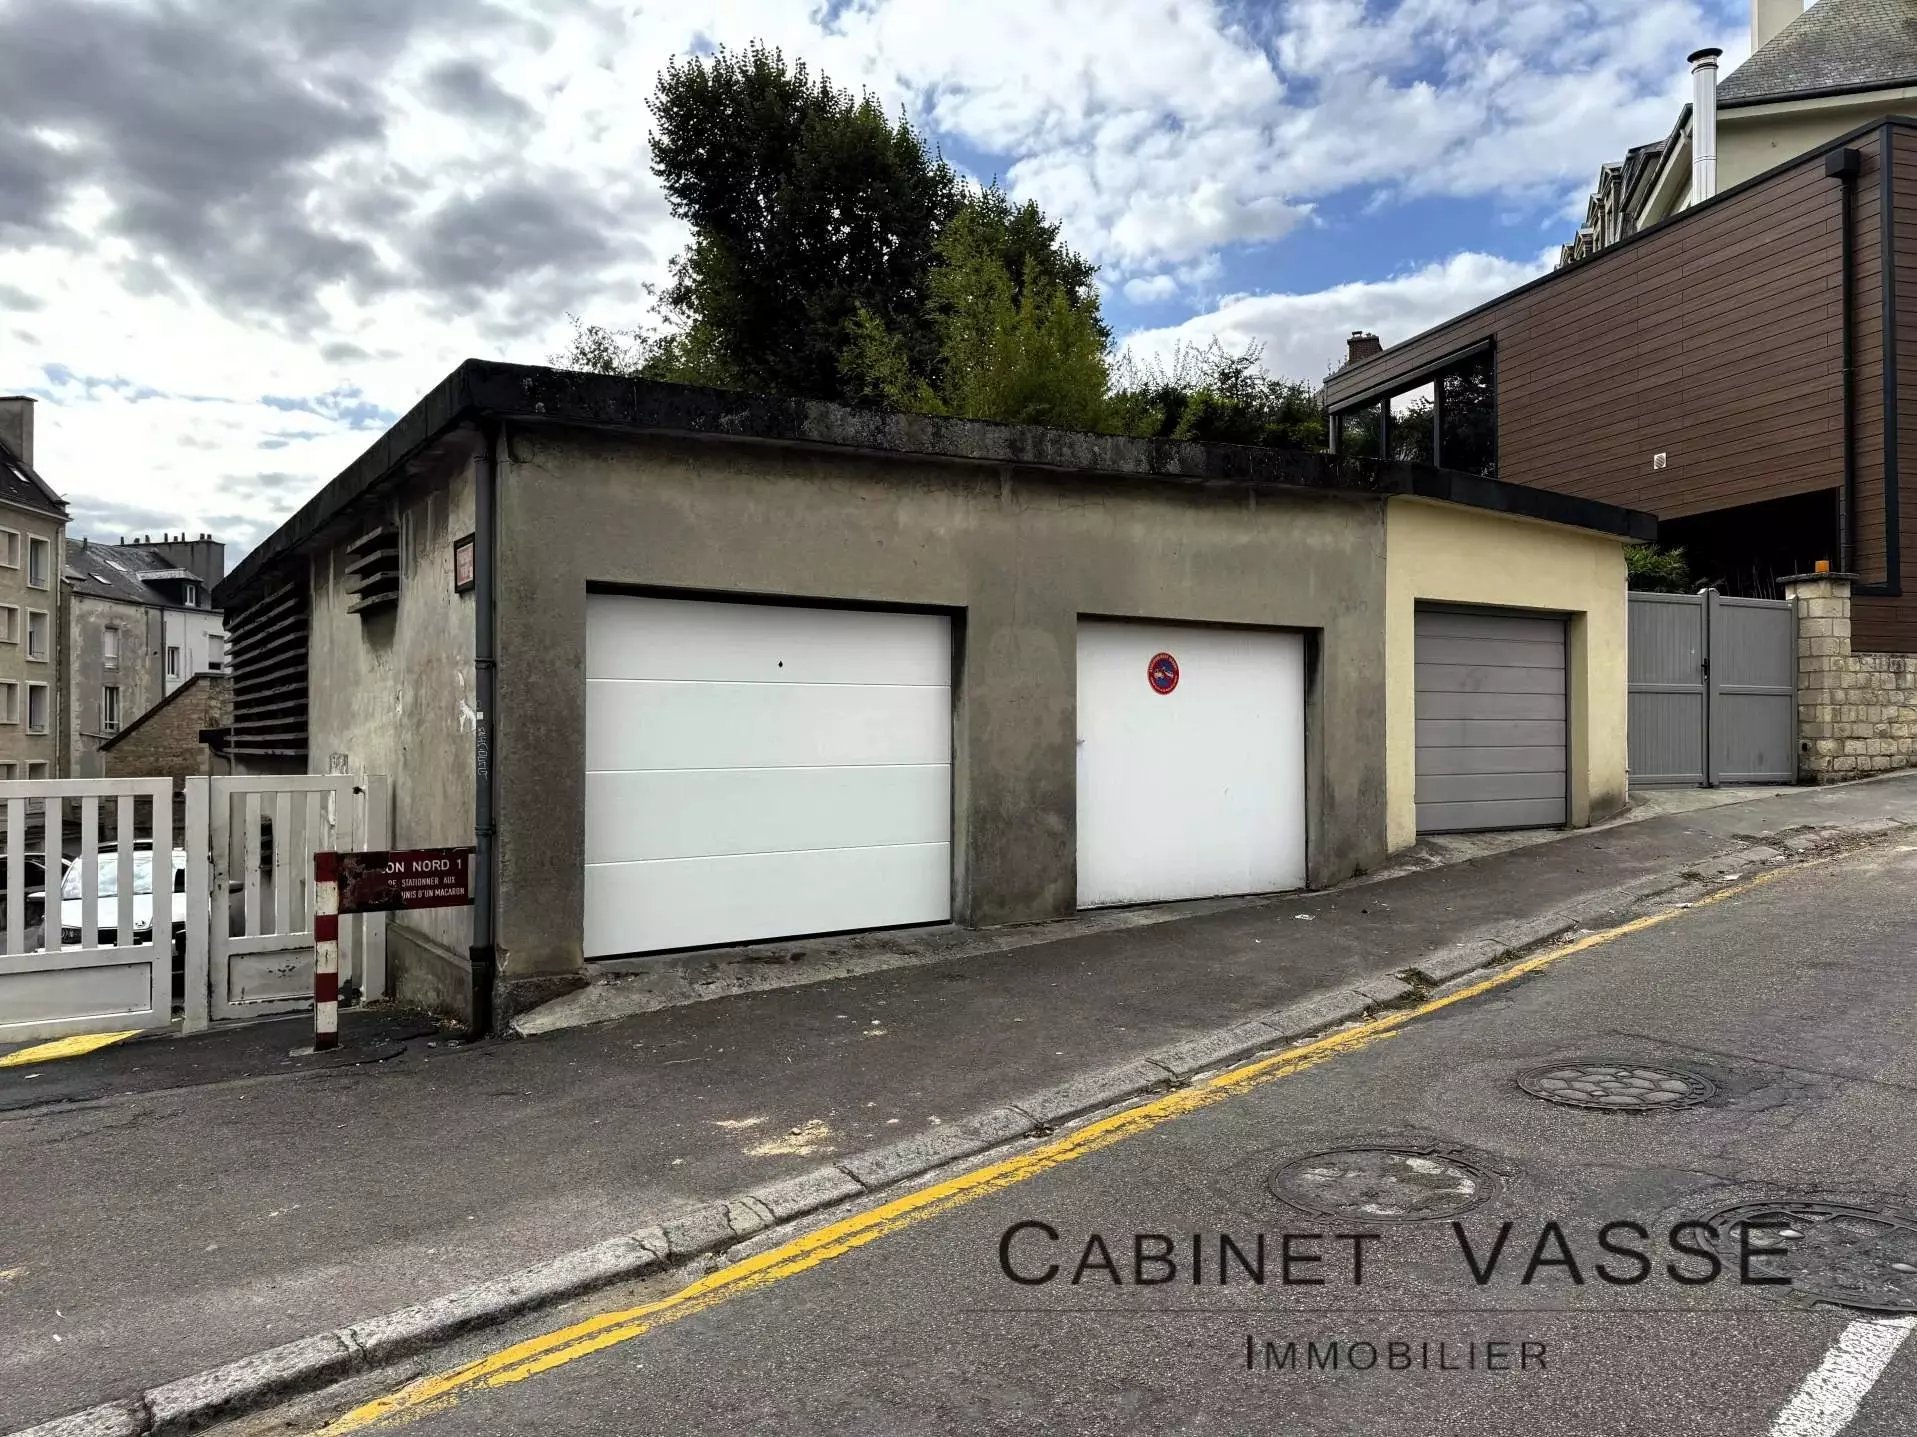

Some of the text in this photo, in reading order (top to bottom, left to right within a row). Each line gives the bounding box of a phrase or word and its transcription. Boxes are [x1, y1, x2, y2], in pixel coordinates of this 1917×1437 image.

[382, 859, 462, 874] ON NORD 1
[401, 877, 439, 887] STATIONNER
[443, 876, 456, 884] AUX
[401, 887, 465, 899] UNIS D'UN MACARON
